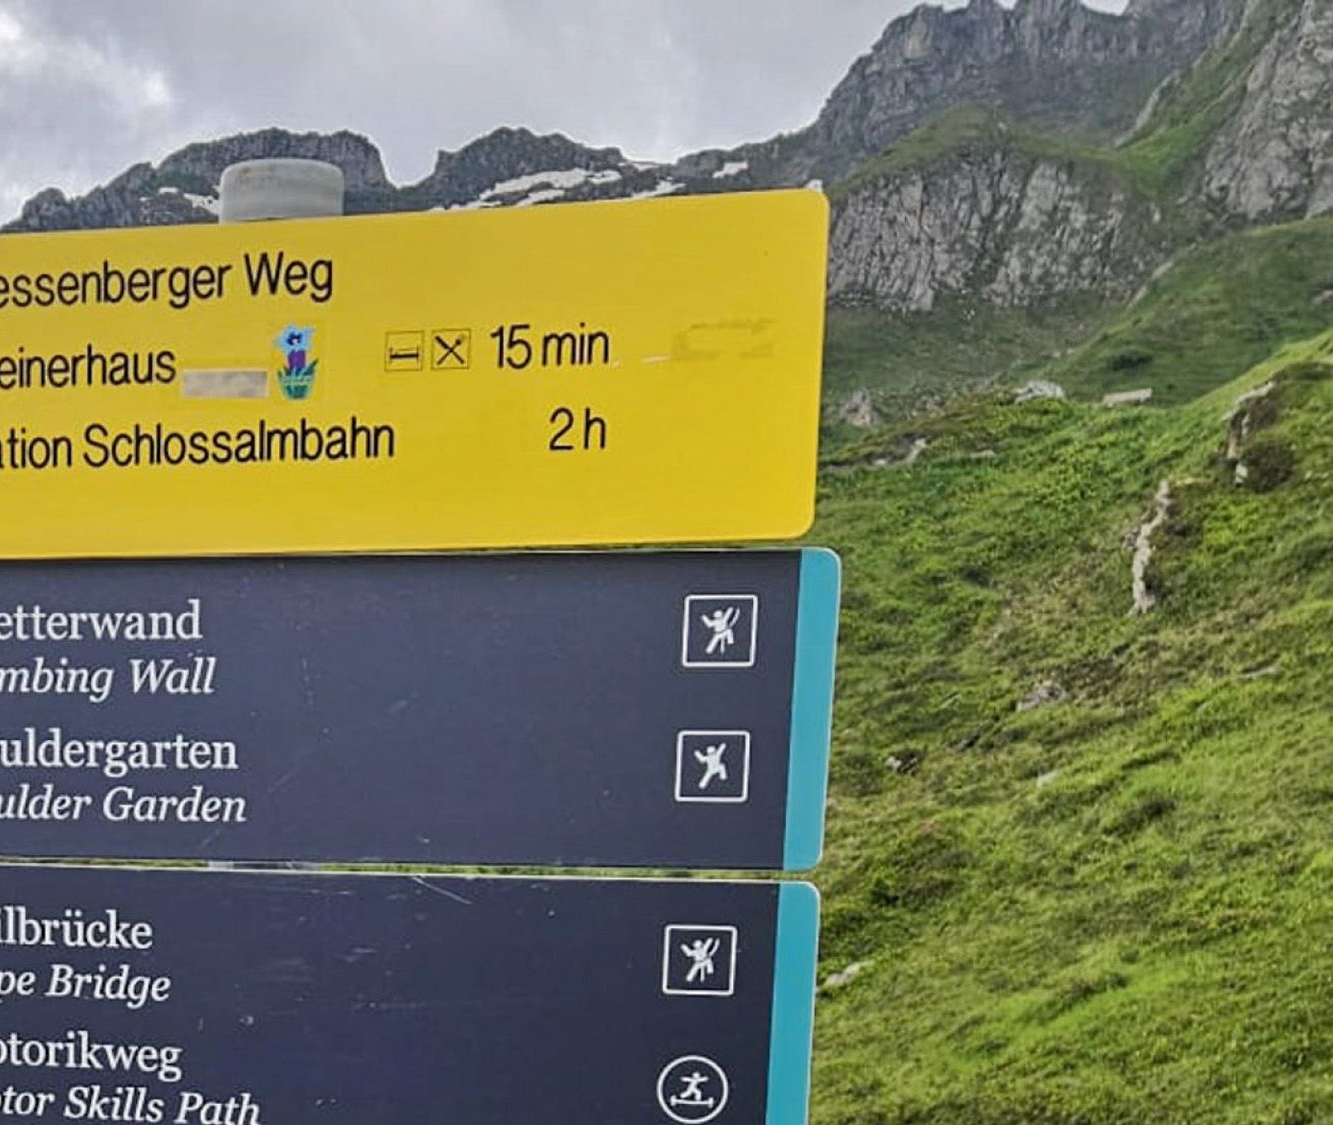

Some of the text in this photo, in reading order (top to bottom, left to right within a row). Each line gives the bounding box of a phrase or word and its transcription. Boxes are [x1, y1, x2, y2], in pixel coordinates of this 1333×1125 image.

[243, 251, 333, 303] Weg
[489, 324, 533, 370] 15
[540, 325, 610, 367] min
[83, 416, 395, 468] Schlossalmbahn
[548, 407, 574, 451] 2
[583, 407, 606, 450] h
[130, 656, 217, 695] Wall
[102, 784, 247, 823] Garden
[44, 963, 171, 1010] Bridge
[63, 1084, 165, 1123] Skills
